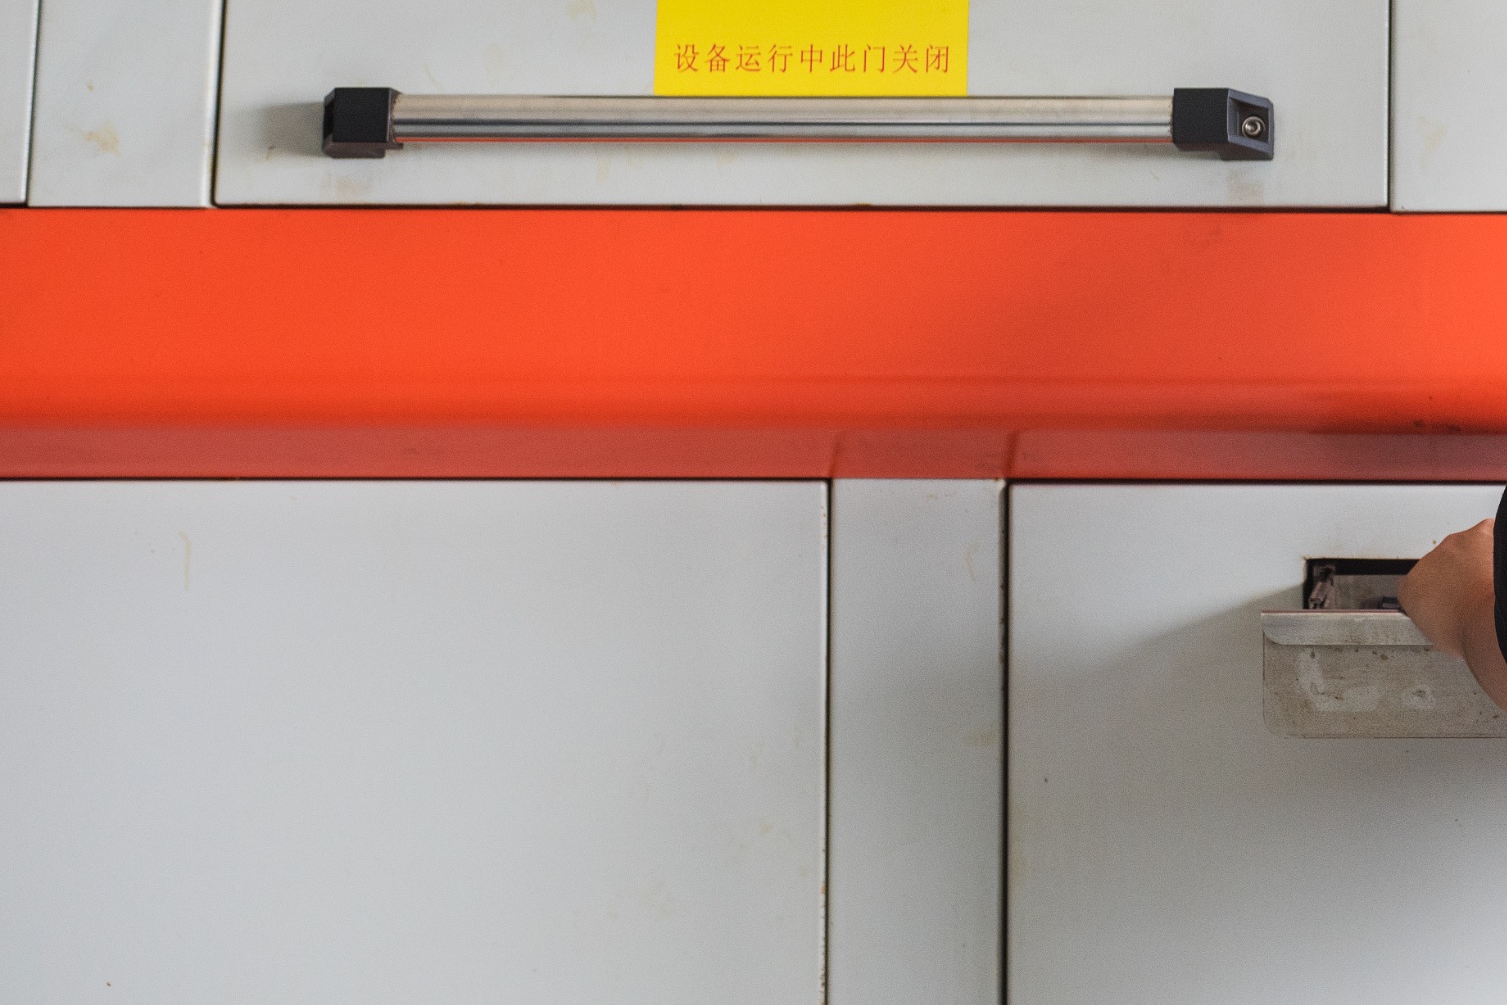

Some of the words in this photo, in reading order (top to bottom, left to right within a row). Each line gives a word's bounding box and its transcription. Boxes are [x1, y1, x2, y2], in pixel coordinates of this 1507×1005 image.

[673, 43, 950, 74] 设备运行中此门关闭
